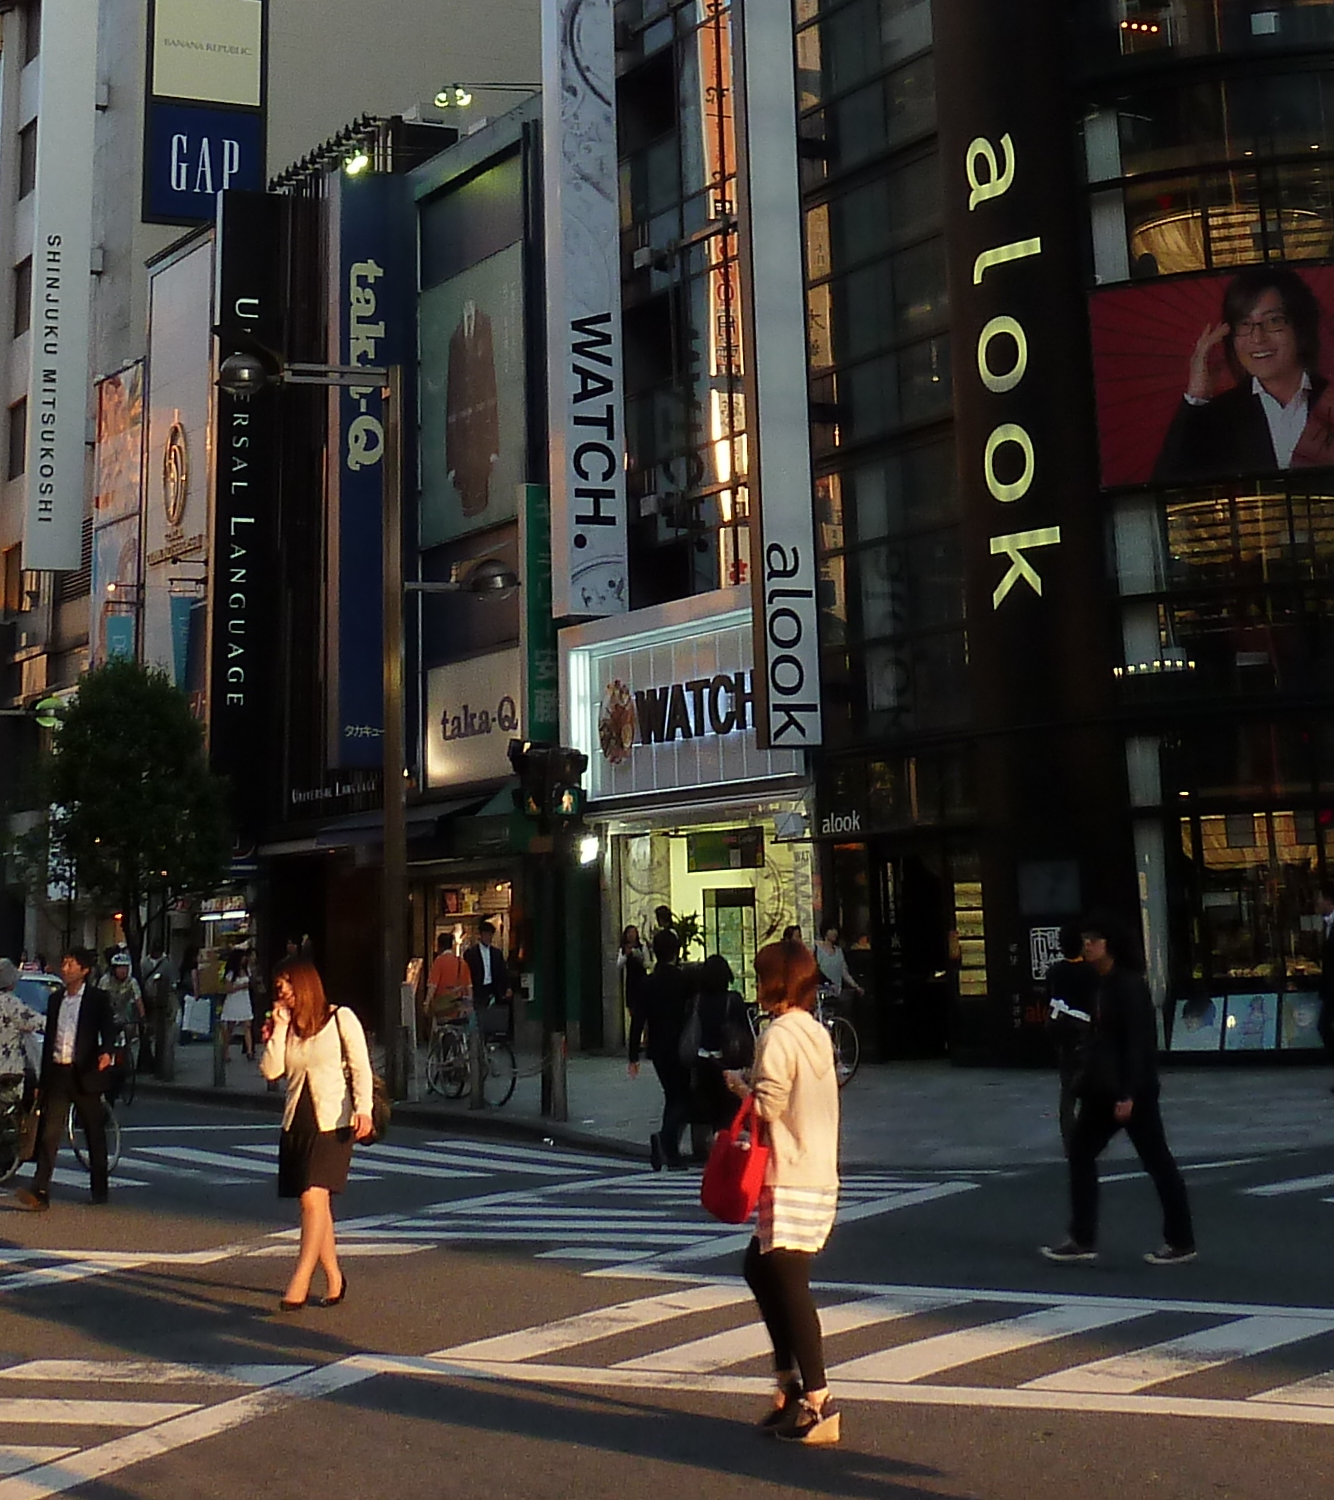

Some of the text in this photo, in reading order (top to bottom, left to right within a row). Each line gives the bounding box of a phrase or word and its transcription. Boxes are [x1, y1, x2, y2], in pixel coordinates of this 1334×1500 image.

[164, 38, 205, 51] BANANA
[170, 133, 241, 194] GAP
[37, 233, 63, 523] SHINJUKU MITSUKOSHI
[346, 258, 386, 471] tak-Q
[965, 131, 1063, 612] alook
[226, 516, 255, 706] LANGUAGE
[765, 540, 820, 741] alook
[345, 724, 386, 738] タカキュー
[440, 695, 519, 743] taka-Q
[821, 812, 861, 835] alook
